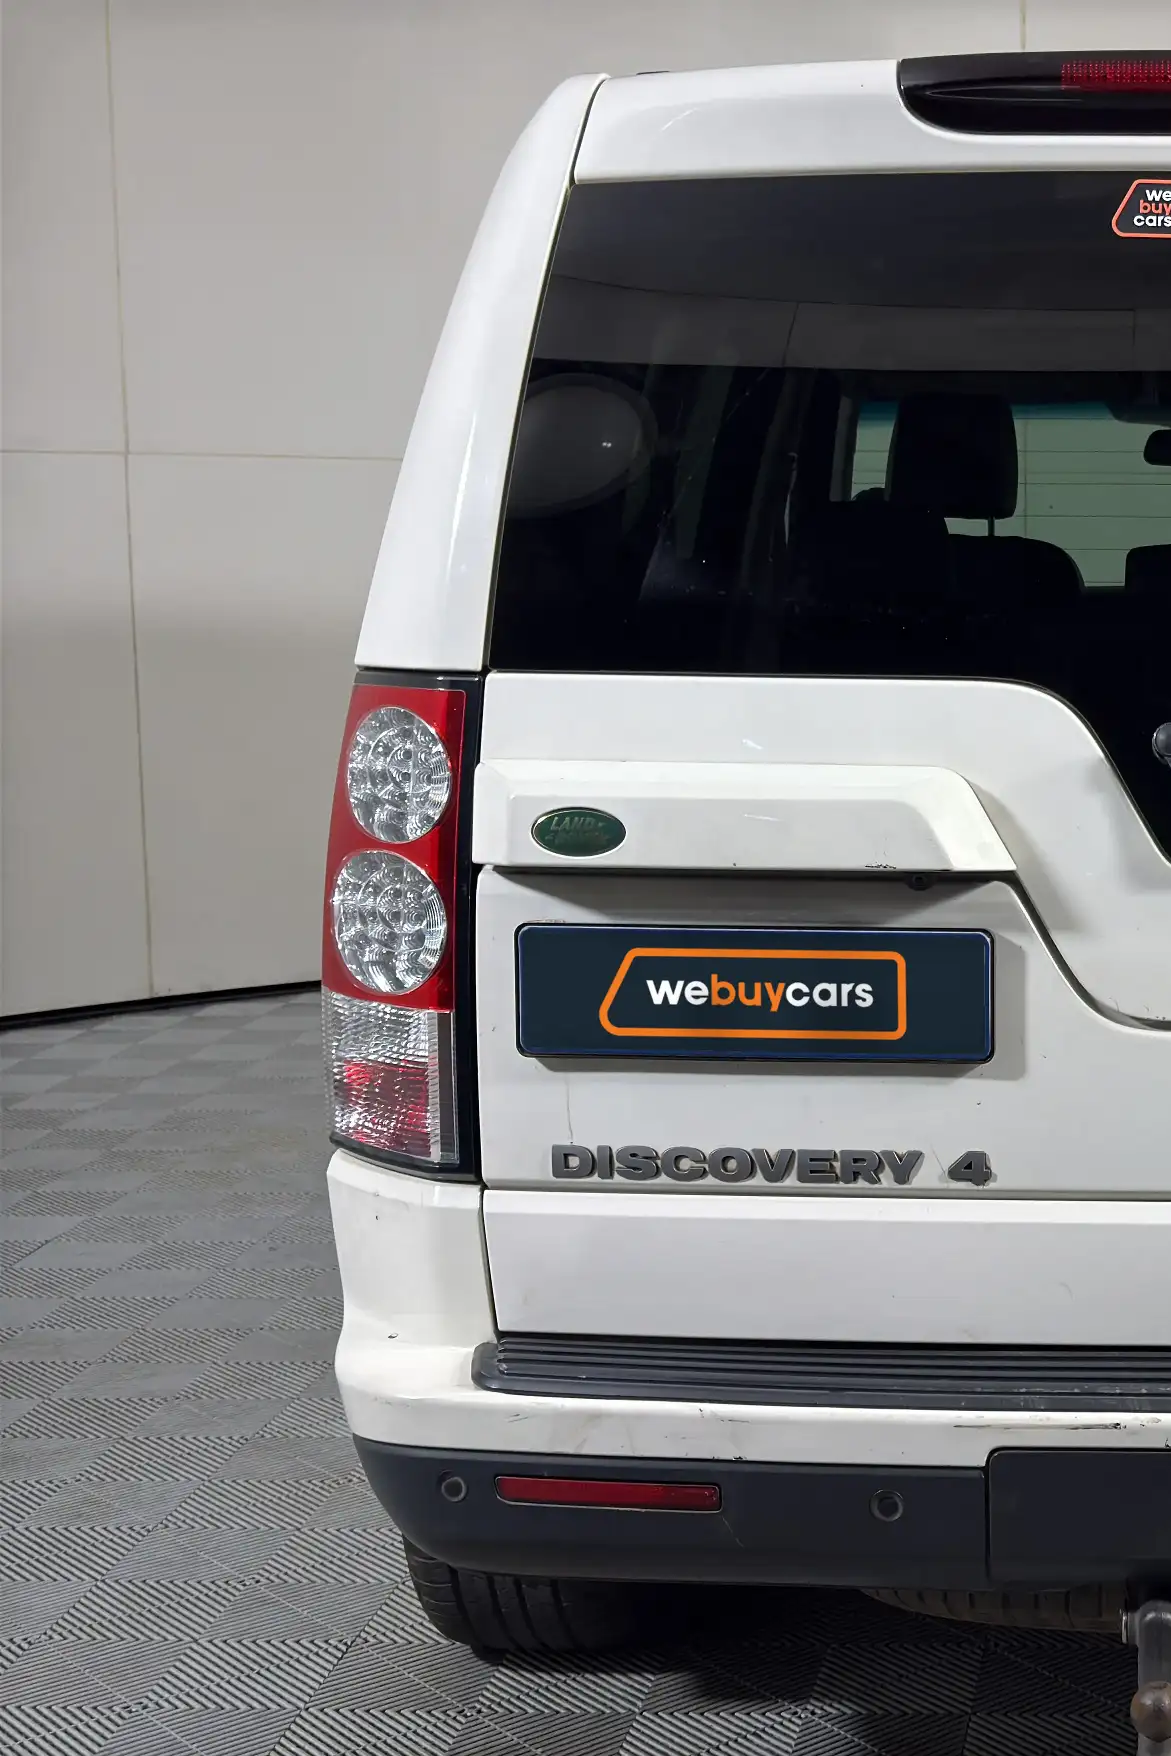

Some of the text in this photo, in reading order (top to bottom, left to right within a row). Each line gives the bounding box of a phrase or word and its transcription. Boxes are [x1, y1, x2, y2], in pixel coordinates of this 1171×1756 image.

[646, 974, 874, 1012] webuycars
[551, 1143, 993, 1186] DISCOVERY 4
